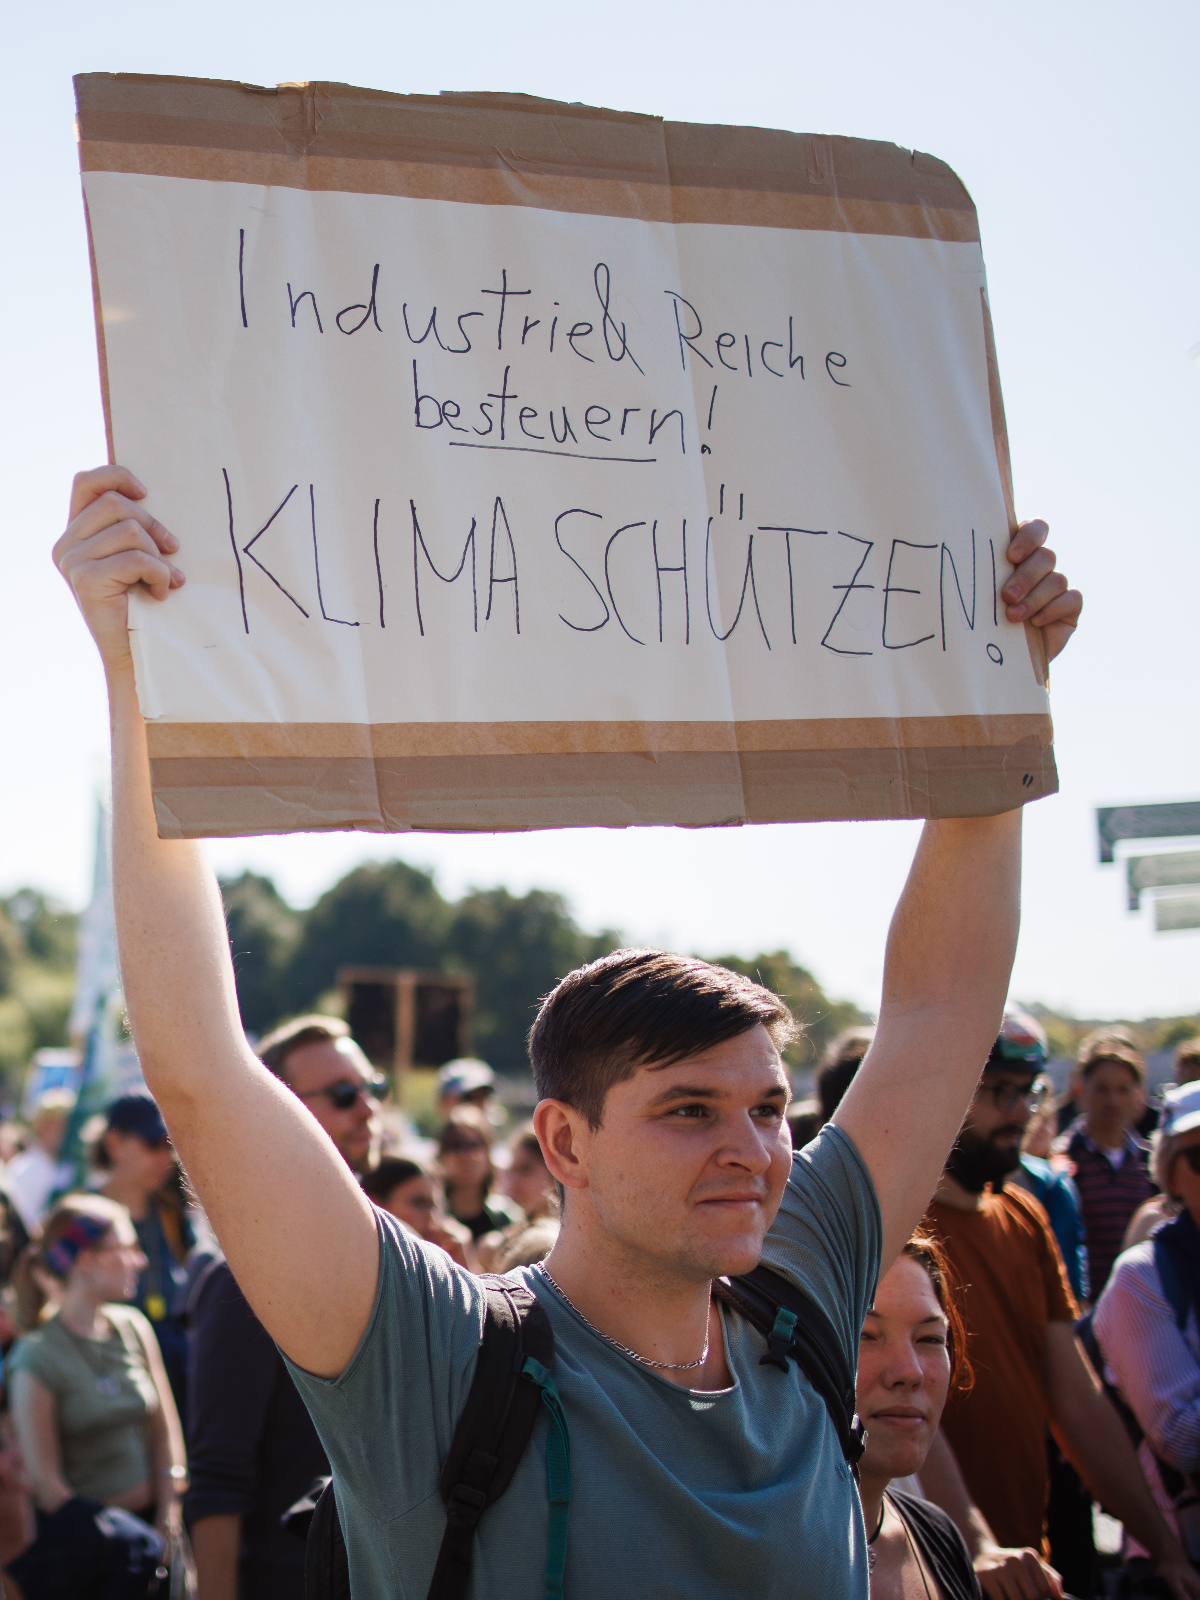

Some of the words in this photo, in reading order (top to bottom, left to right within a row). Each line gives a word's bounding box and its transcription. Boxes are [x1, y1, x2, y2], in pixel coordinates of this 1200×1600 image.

[238, 229, 595, 363] Industrie
[664, 291, 852, 387] Reiche
[413, 359, 718, 456] besteuern!
[222, 467, 522, 637] KLIMA
[554, 483, 1004, 666] SCHÜTZEN!
